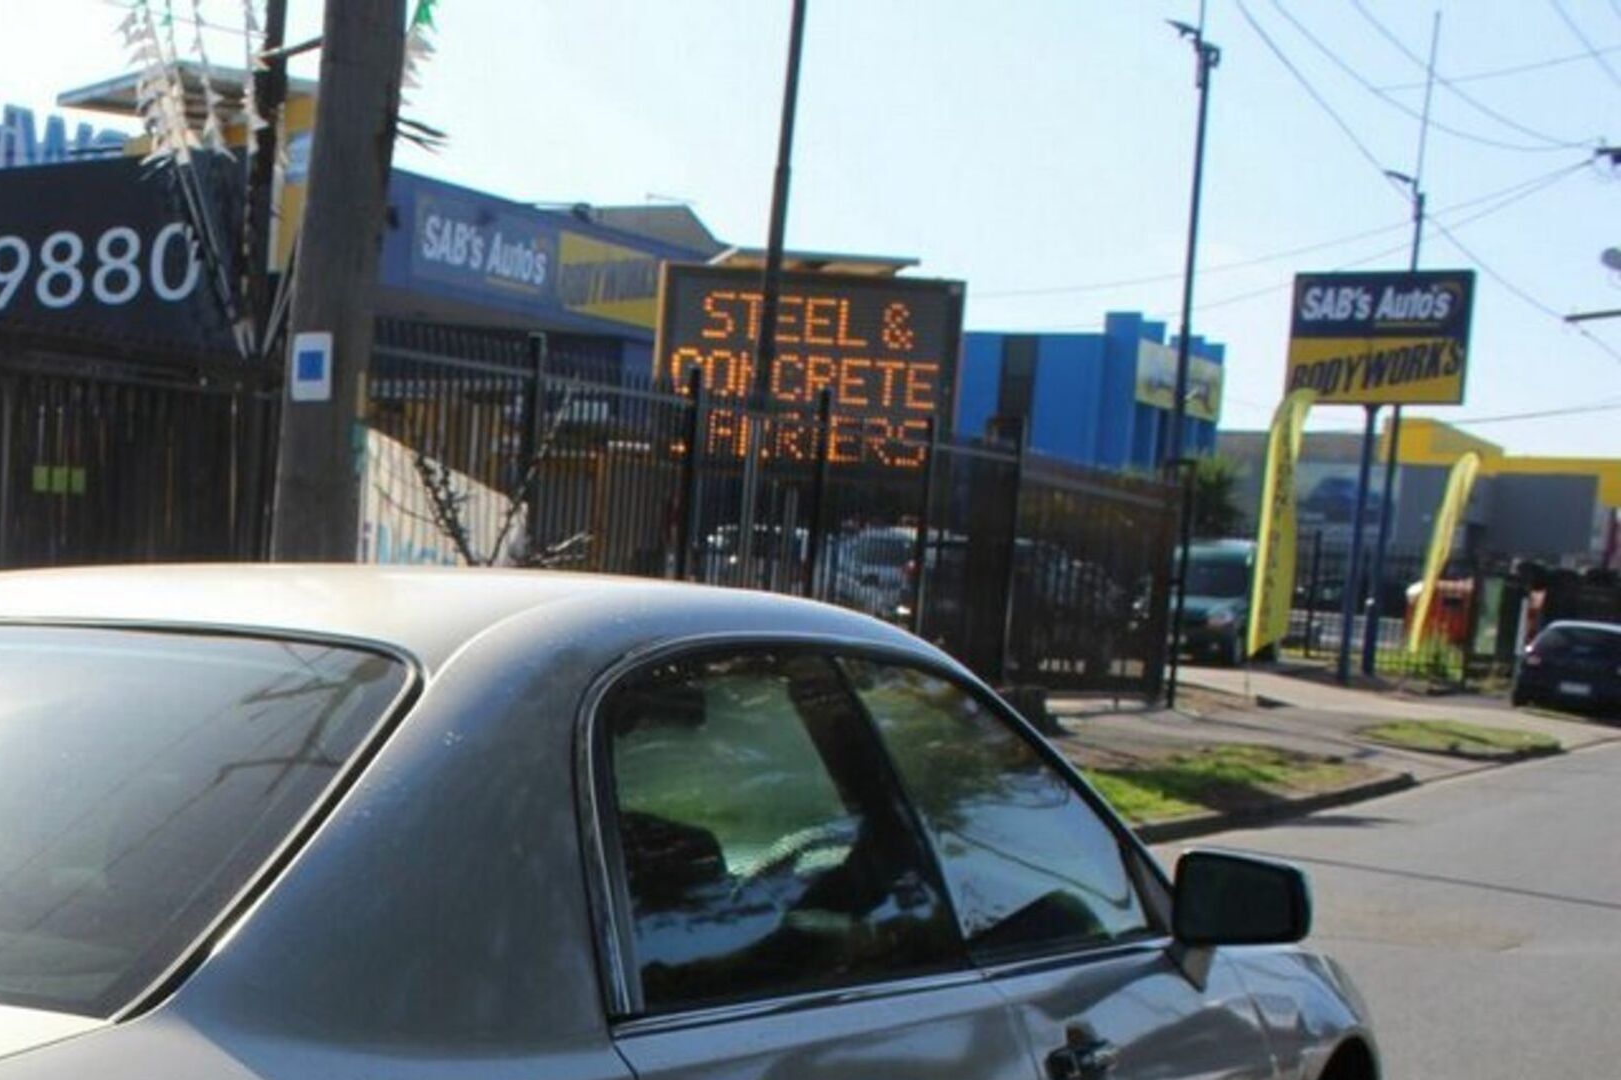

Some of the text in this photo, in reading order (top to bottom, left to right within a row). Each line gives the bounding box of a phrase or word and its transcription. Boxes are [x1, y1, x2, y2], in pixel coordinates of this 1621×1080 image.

[423, 215, 484, 270] SAB's
[701, 291, 915, 350] STEEL &
[1300, 285, 1452, 321] SAB's Auto's
